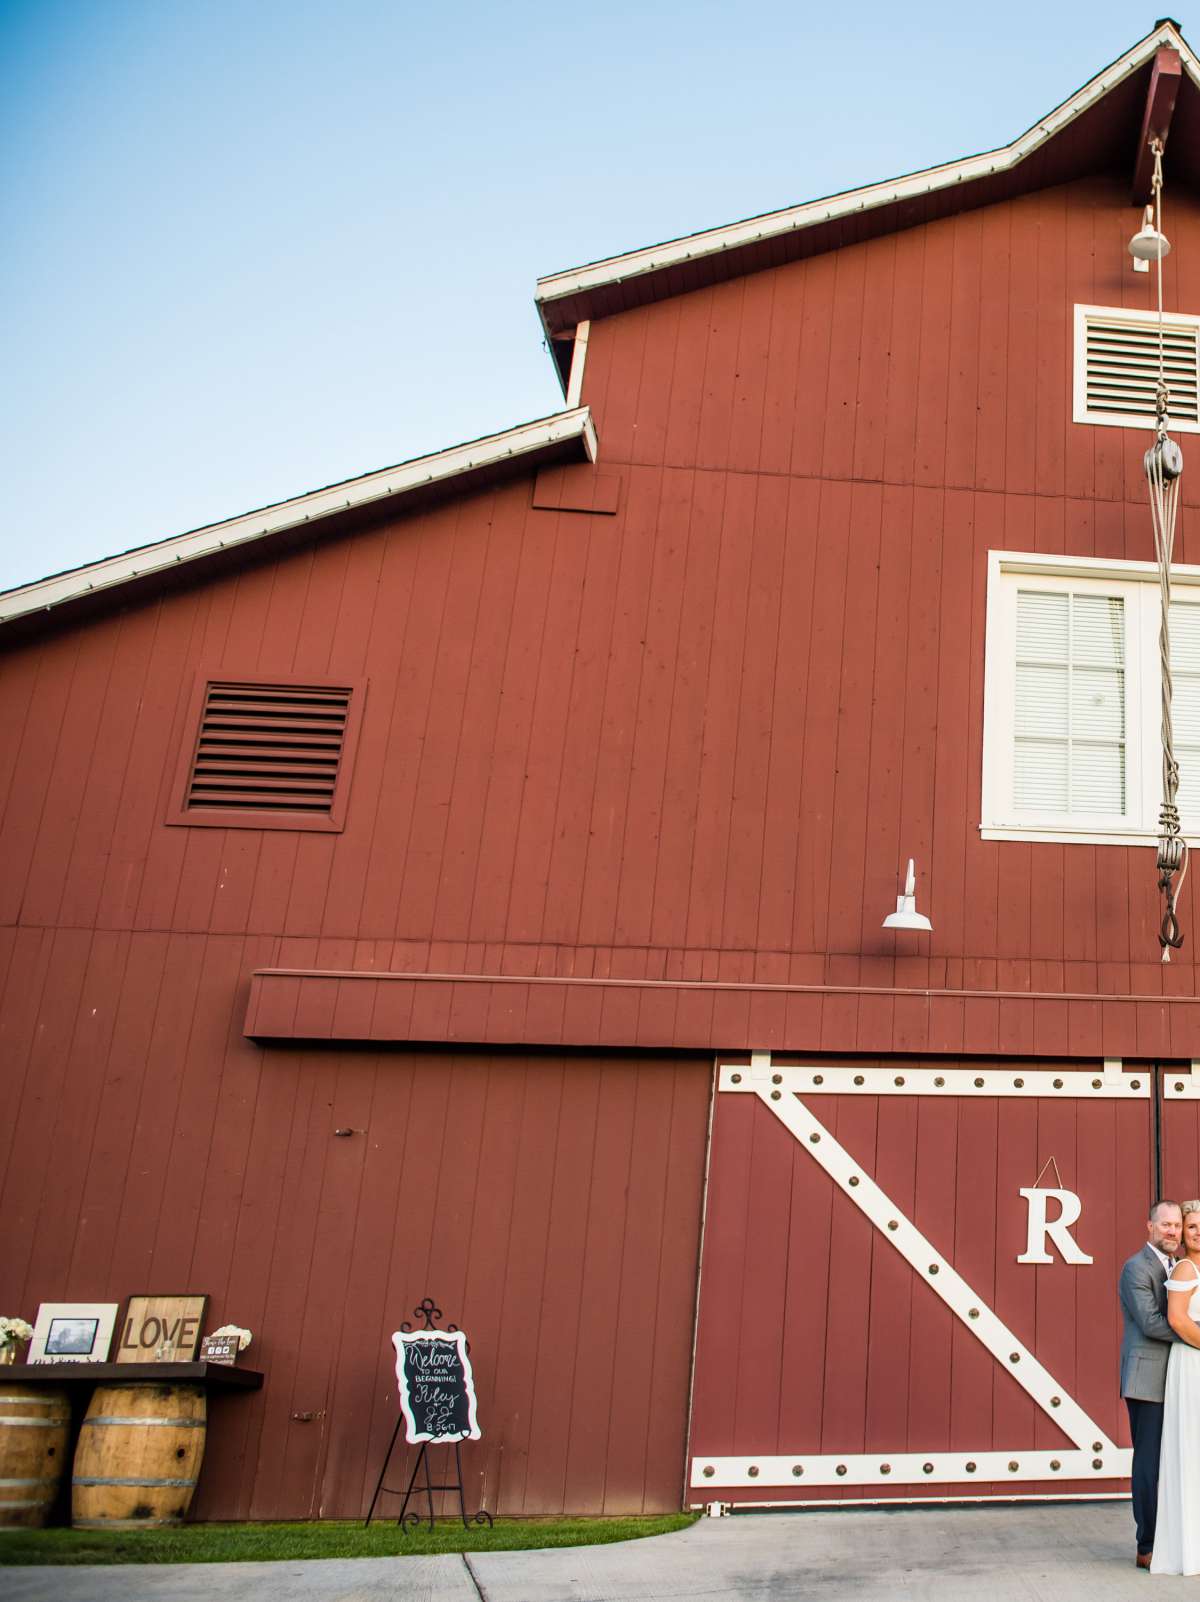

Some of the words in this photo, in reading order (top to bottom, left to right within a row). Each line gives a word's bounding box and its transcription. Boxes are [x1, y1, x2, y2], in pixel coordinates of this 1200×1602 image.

[1016, 1187, 1094, 1265] R
[122, 1316, 200, 1349] LOVE
[406, 1345, 460, 1371] Welcome
